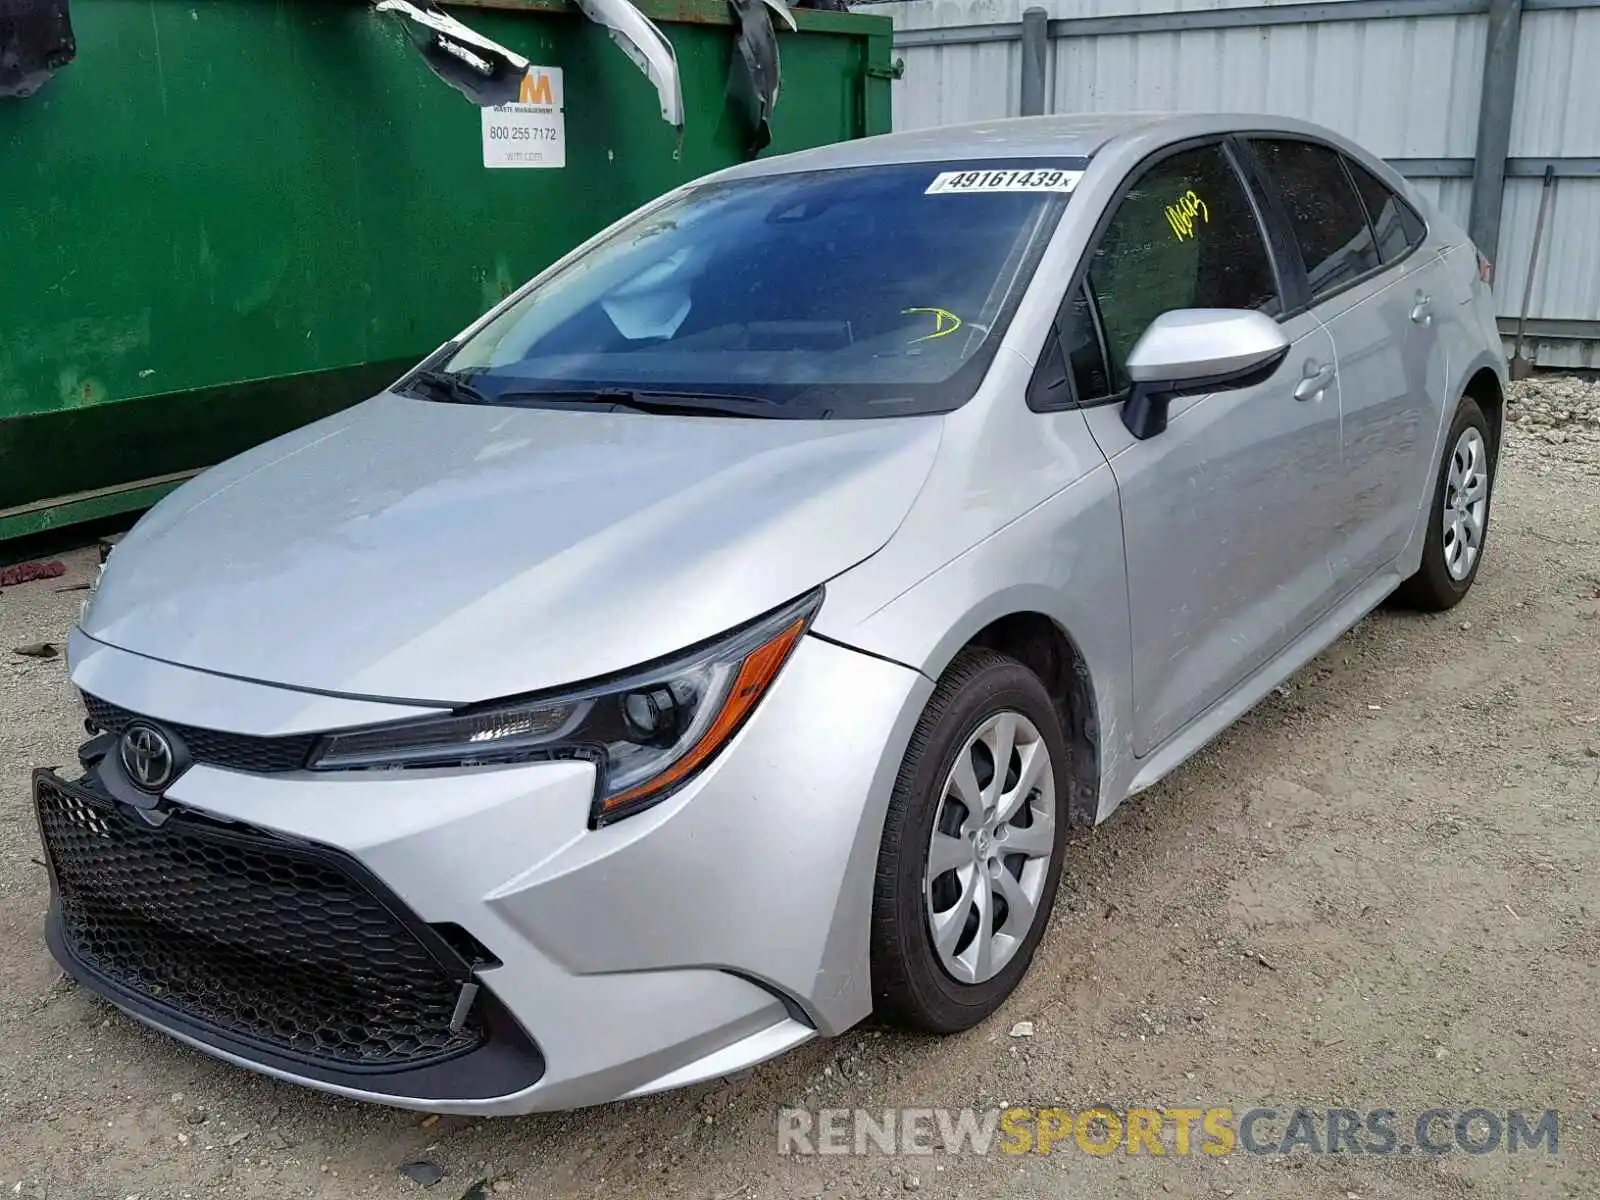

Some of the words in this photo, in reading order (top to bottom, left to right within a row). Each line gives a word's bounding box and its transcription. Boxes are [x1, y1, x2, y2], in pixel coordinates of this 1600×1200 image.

[490, 126, 509, 140] 800
[512, 127, 530, 140] 255
[533, 127, 557, 141] 7172
